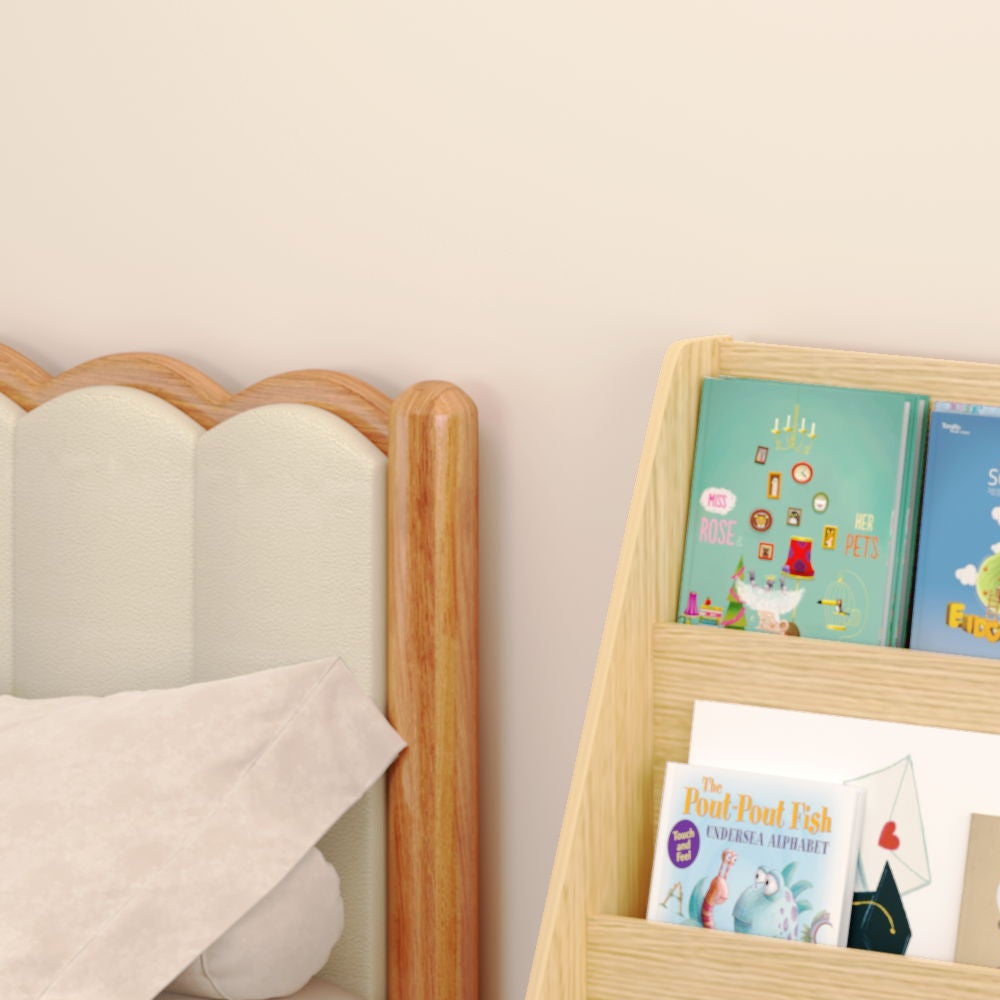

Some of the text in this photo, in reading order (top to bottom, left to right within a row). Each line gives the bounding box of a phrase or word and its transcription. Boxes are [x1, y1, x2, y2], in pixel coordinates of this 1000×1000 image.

[707, 494, 728, 508] MISS
[699, 517, 738, 547] ROSE
[854, 512, 875, 531] HER
[845, 534, 879, 560] PETS
[702, 776, 723, 794] The
[681, 786, 833, 835] Pout-Pout Fish
[672, 828, 695, 841] Touch
[706, 825, 831, 856] UNDERSEA ALPHABET
